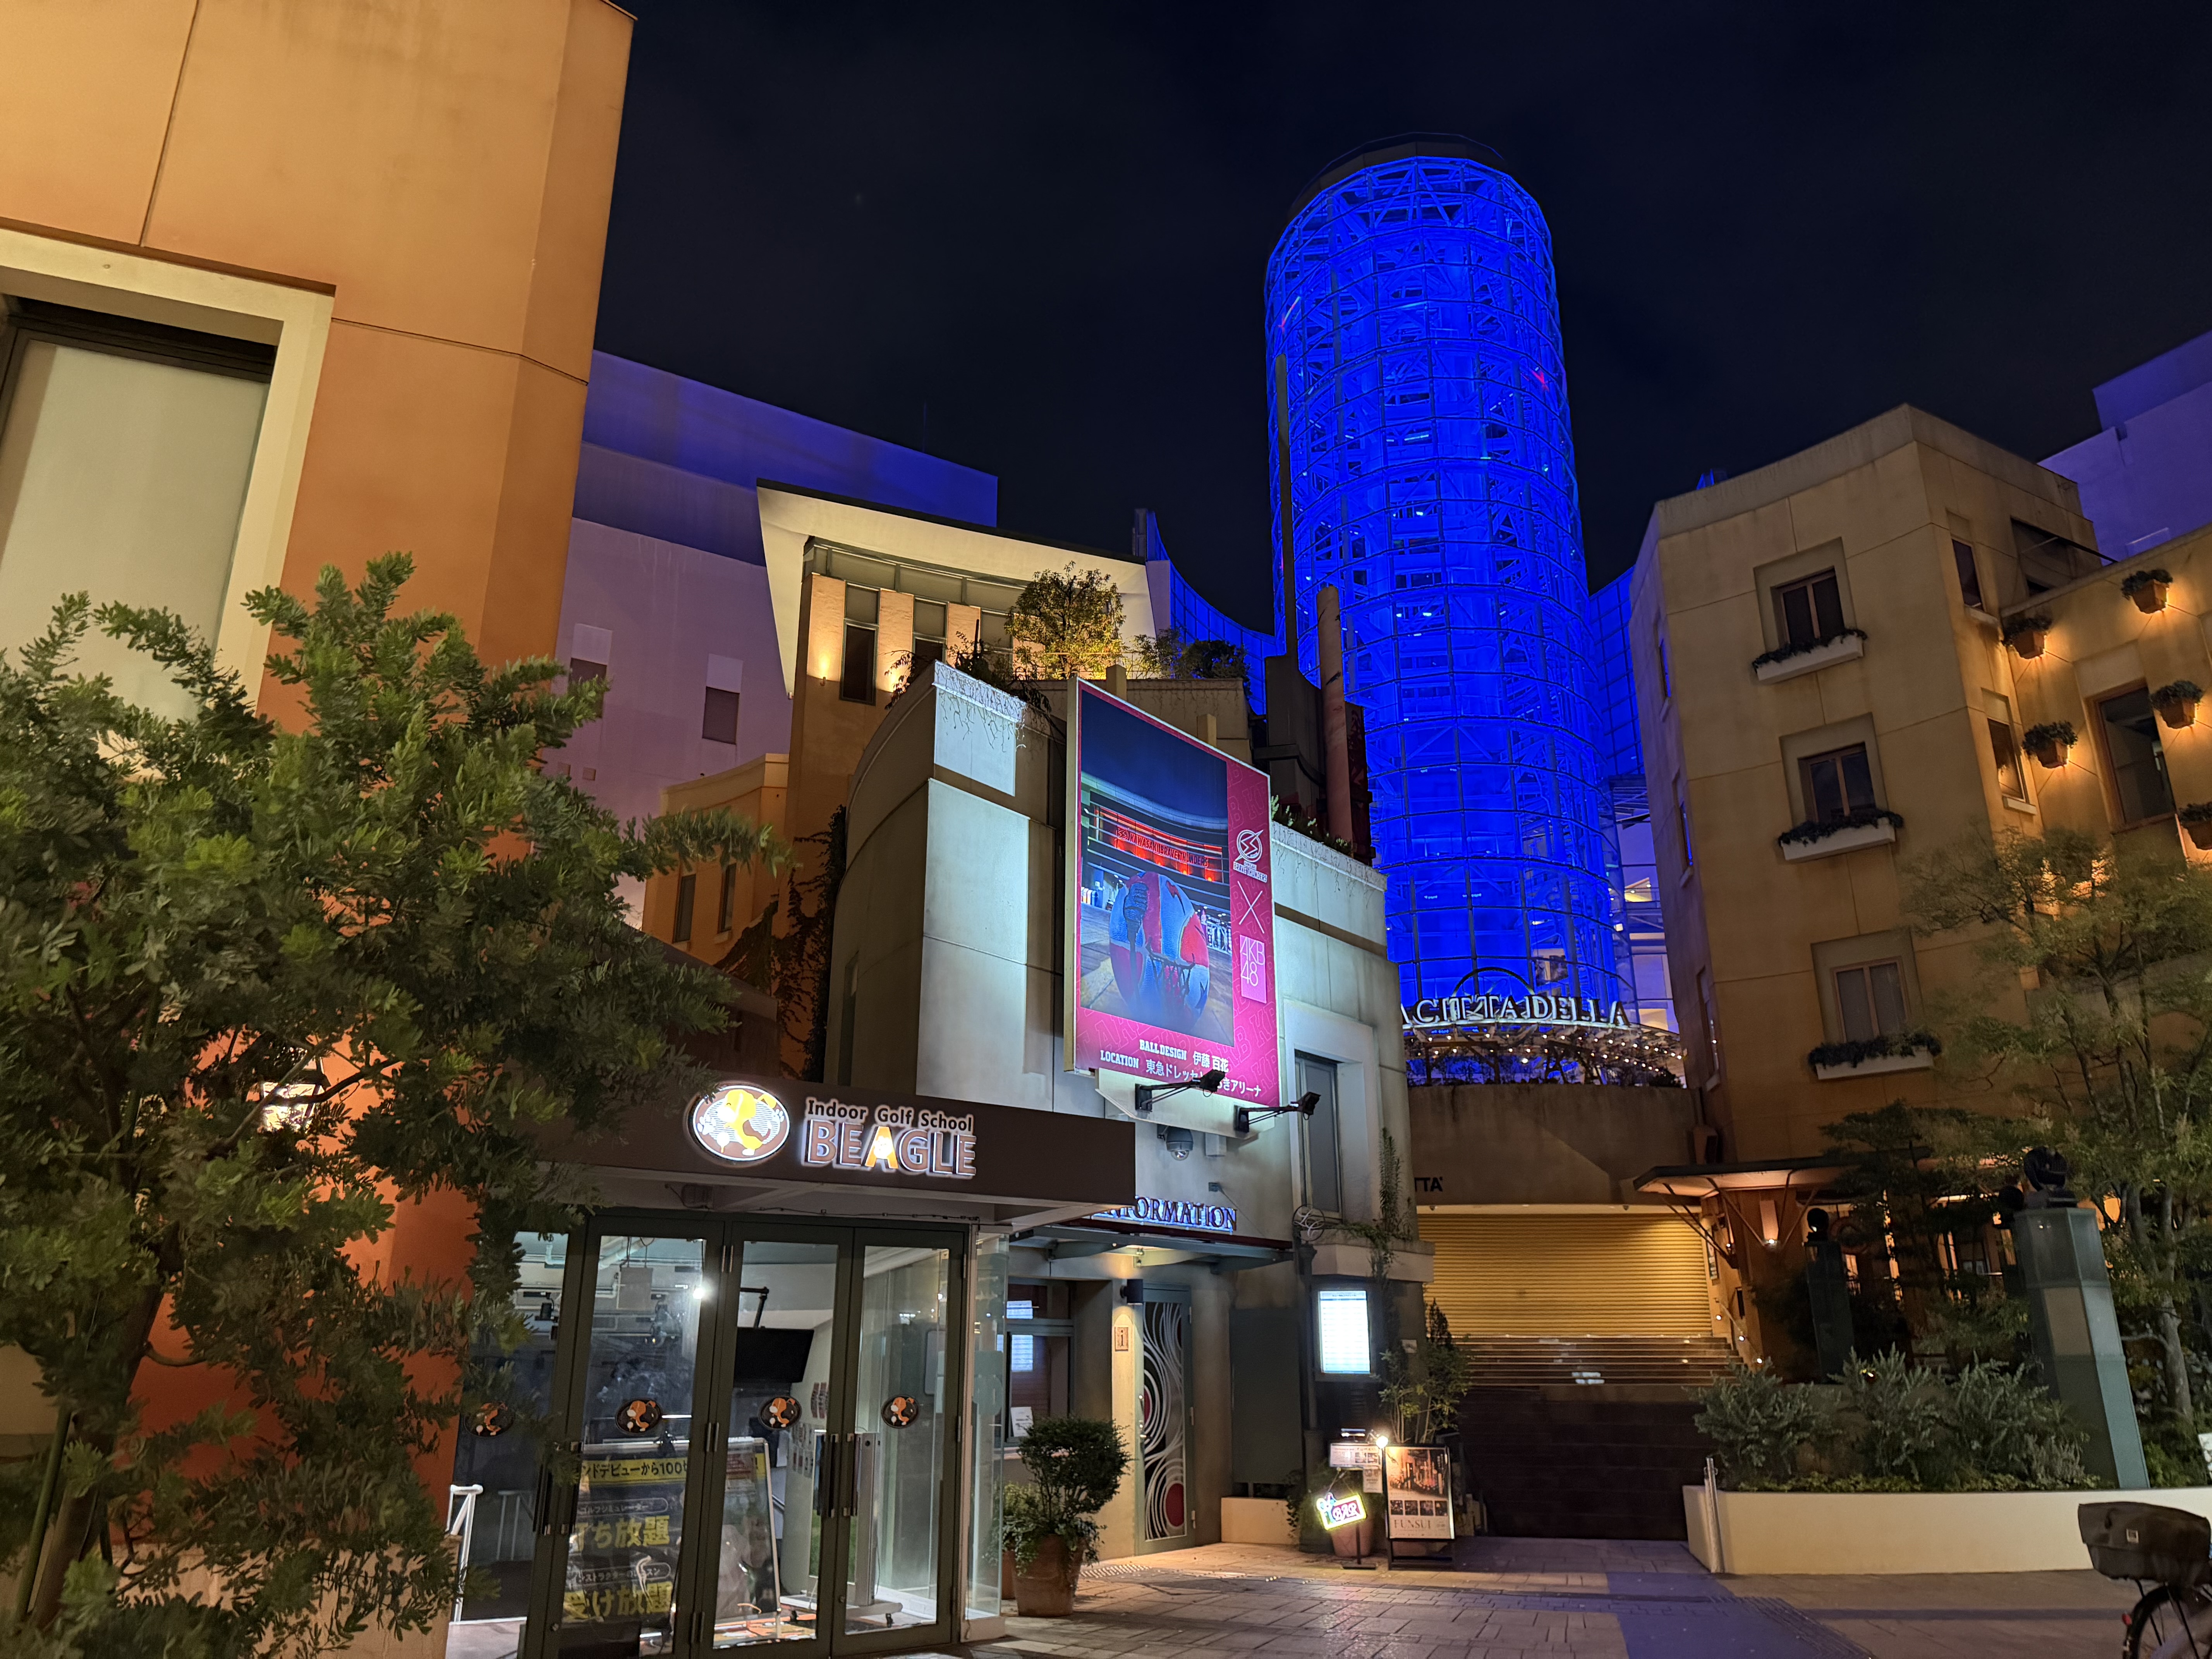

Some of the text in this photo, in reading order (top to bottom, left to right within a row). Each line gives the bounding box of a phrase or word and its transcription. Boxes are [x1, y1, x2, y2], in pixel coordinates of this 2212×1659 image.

[1240, 936, 1265, 966] AKB
[1240, 960, 1258, 987] 48
[1139, 1039, 1159, 1054] BALL
[1159, 1044, 1187, 1061] DESIGN
[1100, 1049, 1262, 1097] LOCATION 東急ドレッセきアリーナ
[808, 1099, 972, 1132] Indoor Golf School
[806, 1118, 977, 1176] BEAGLE
[1108, 1197, 1238, 1231] ORMATION
